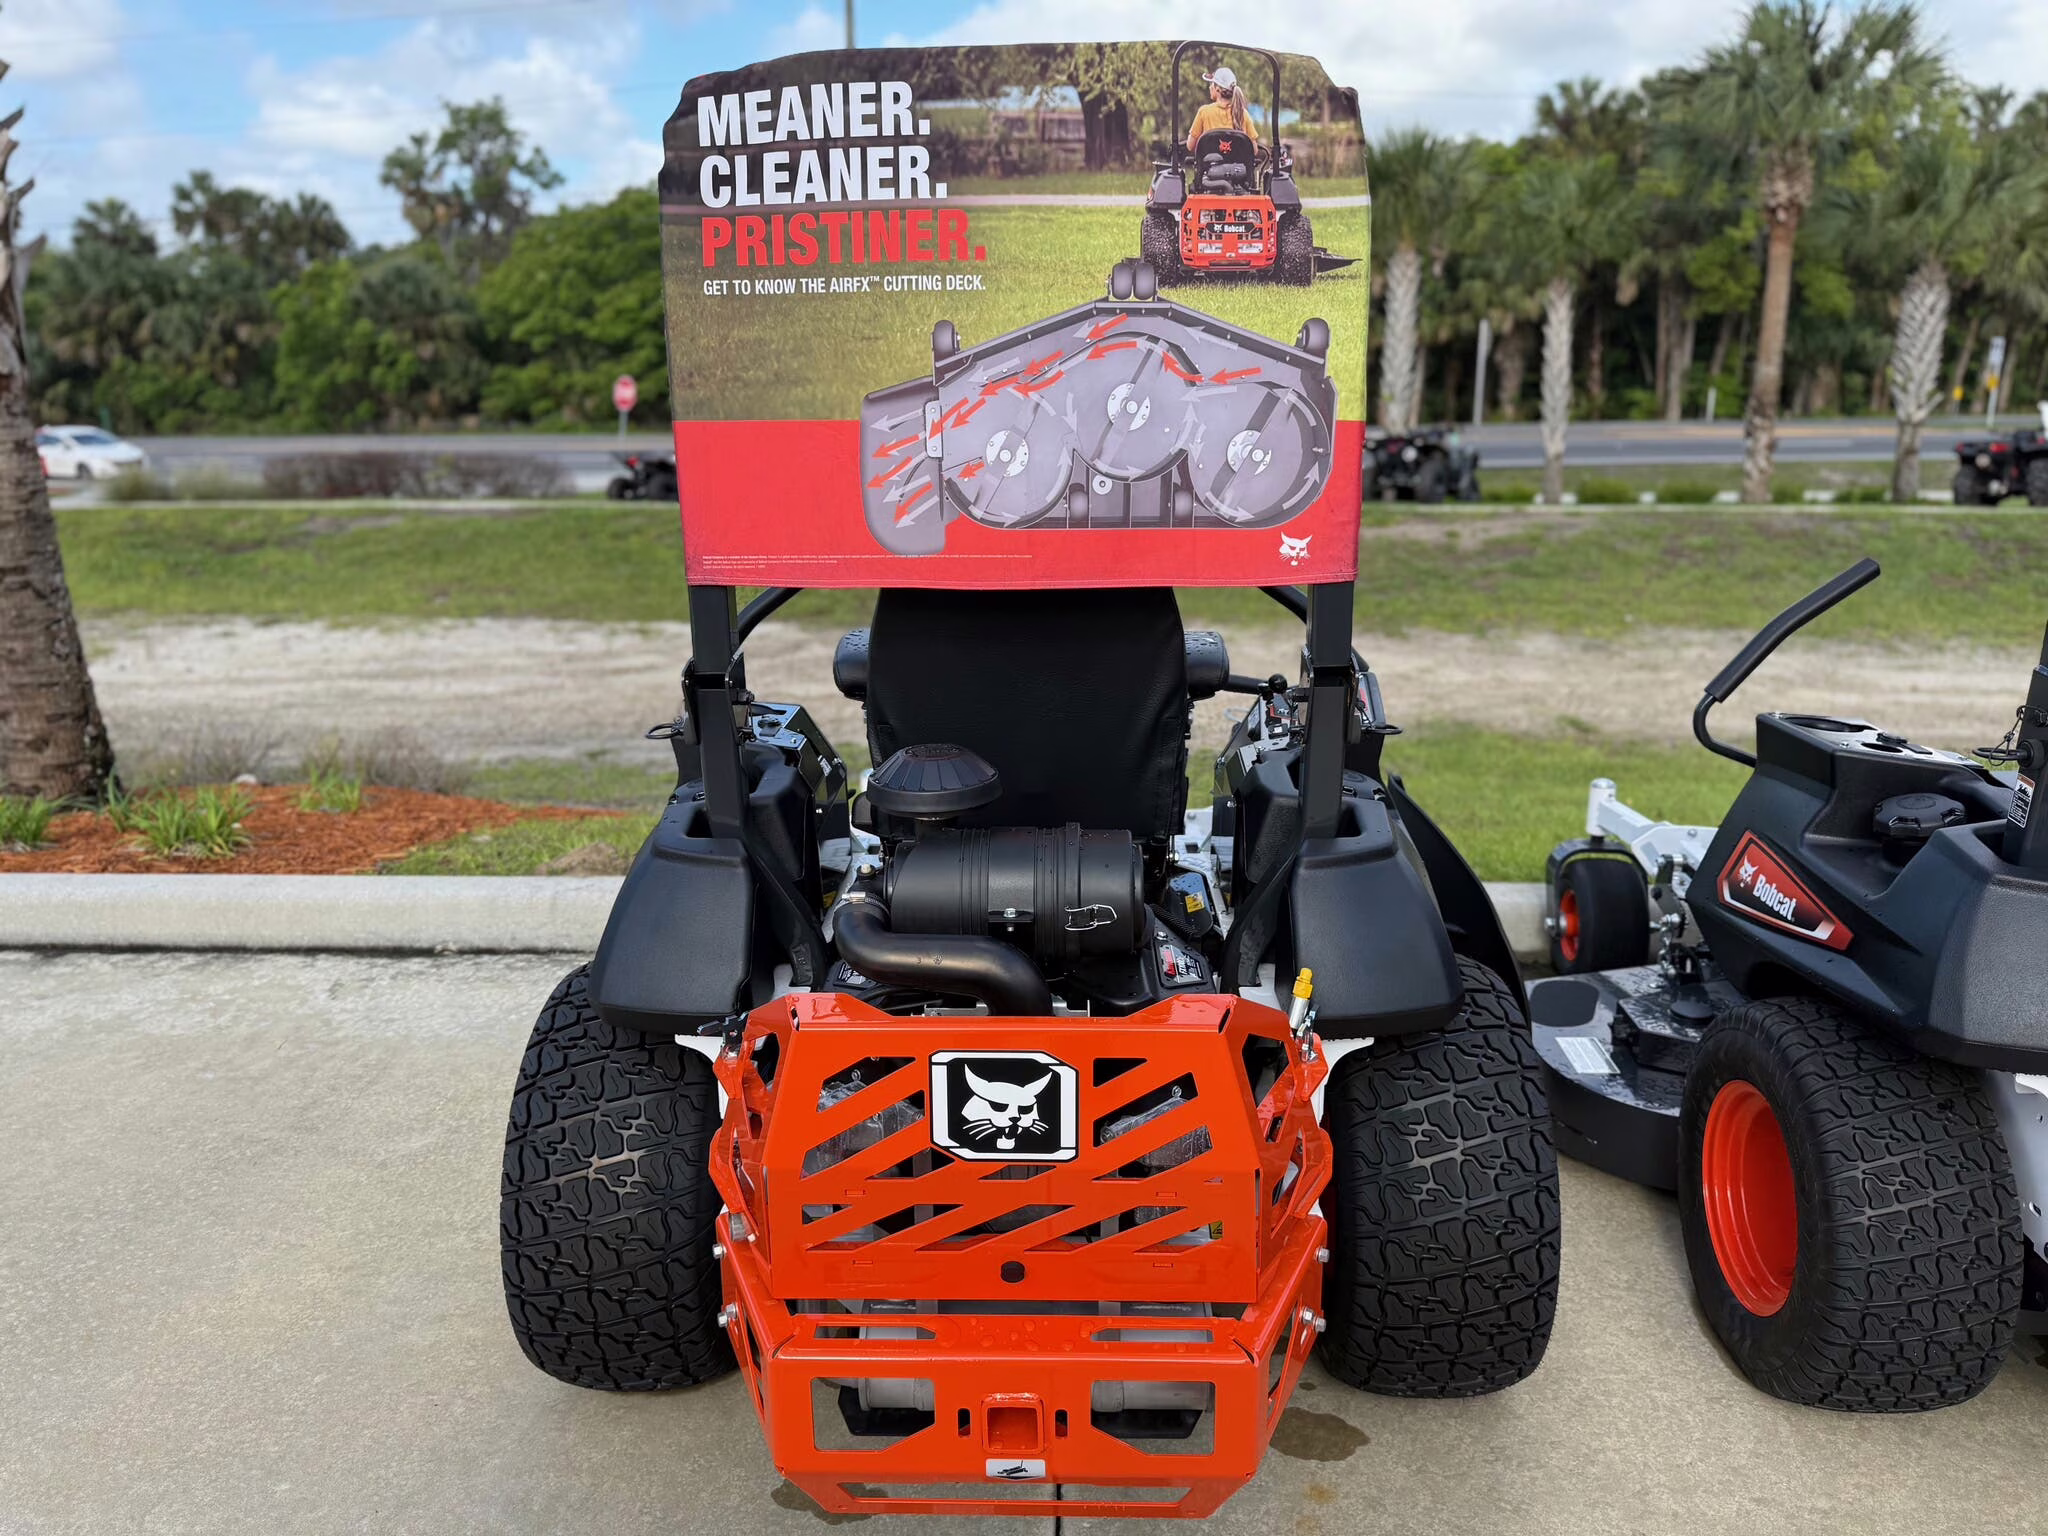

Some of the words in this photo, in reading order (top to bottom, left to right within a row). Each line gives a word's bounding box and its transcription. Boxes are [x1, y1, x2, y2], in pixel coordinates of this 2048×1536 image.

[697, 81, 931, 147] MEANER.
[700, 145, 948, 208] CLEANER.
[701, 208, 988, 267] PRISTINER.
[703, 279, 729, 296] GET
[732, 279, 751, 295] TO
[755, 278, 796, 295] KNOW
[800, 277, 826, 294] THE
[883, 275, 942, 292] CUTTING
[946, 274, 987, 291] DECK.
[1752, 873, 1797, 921] Bobcat
